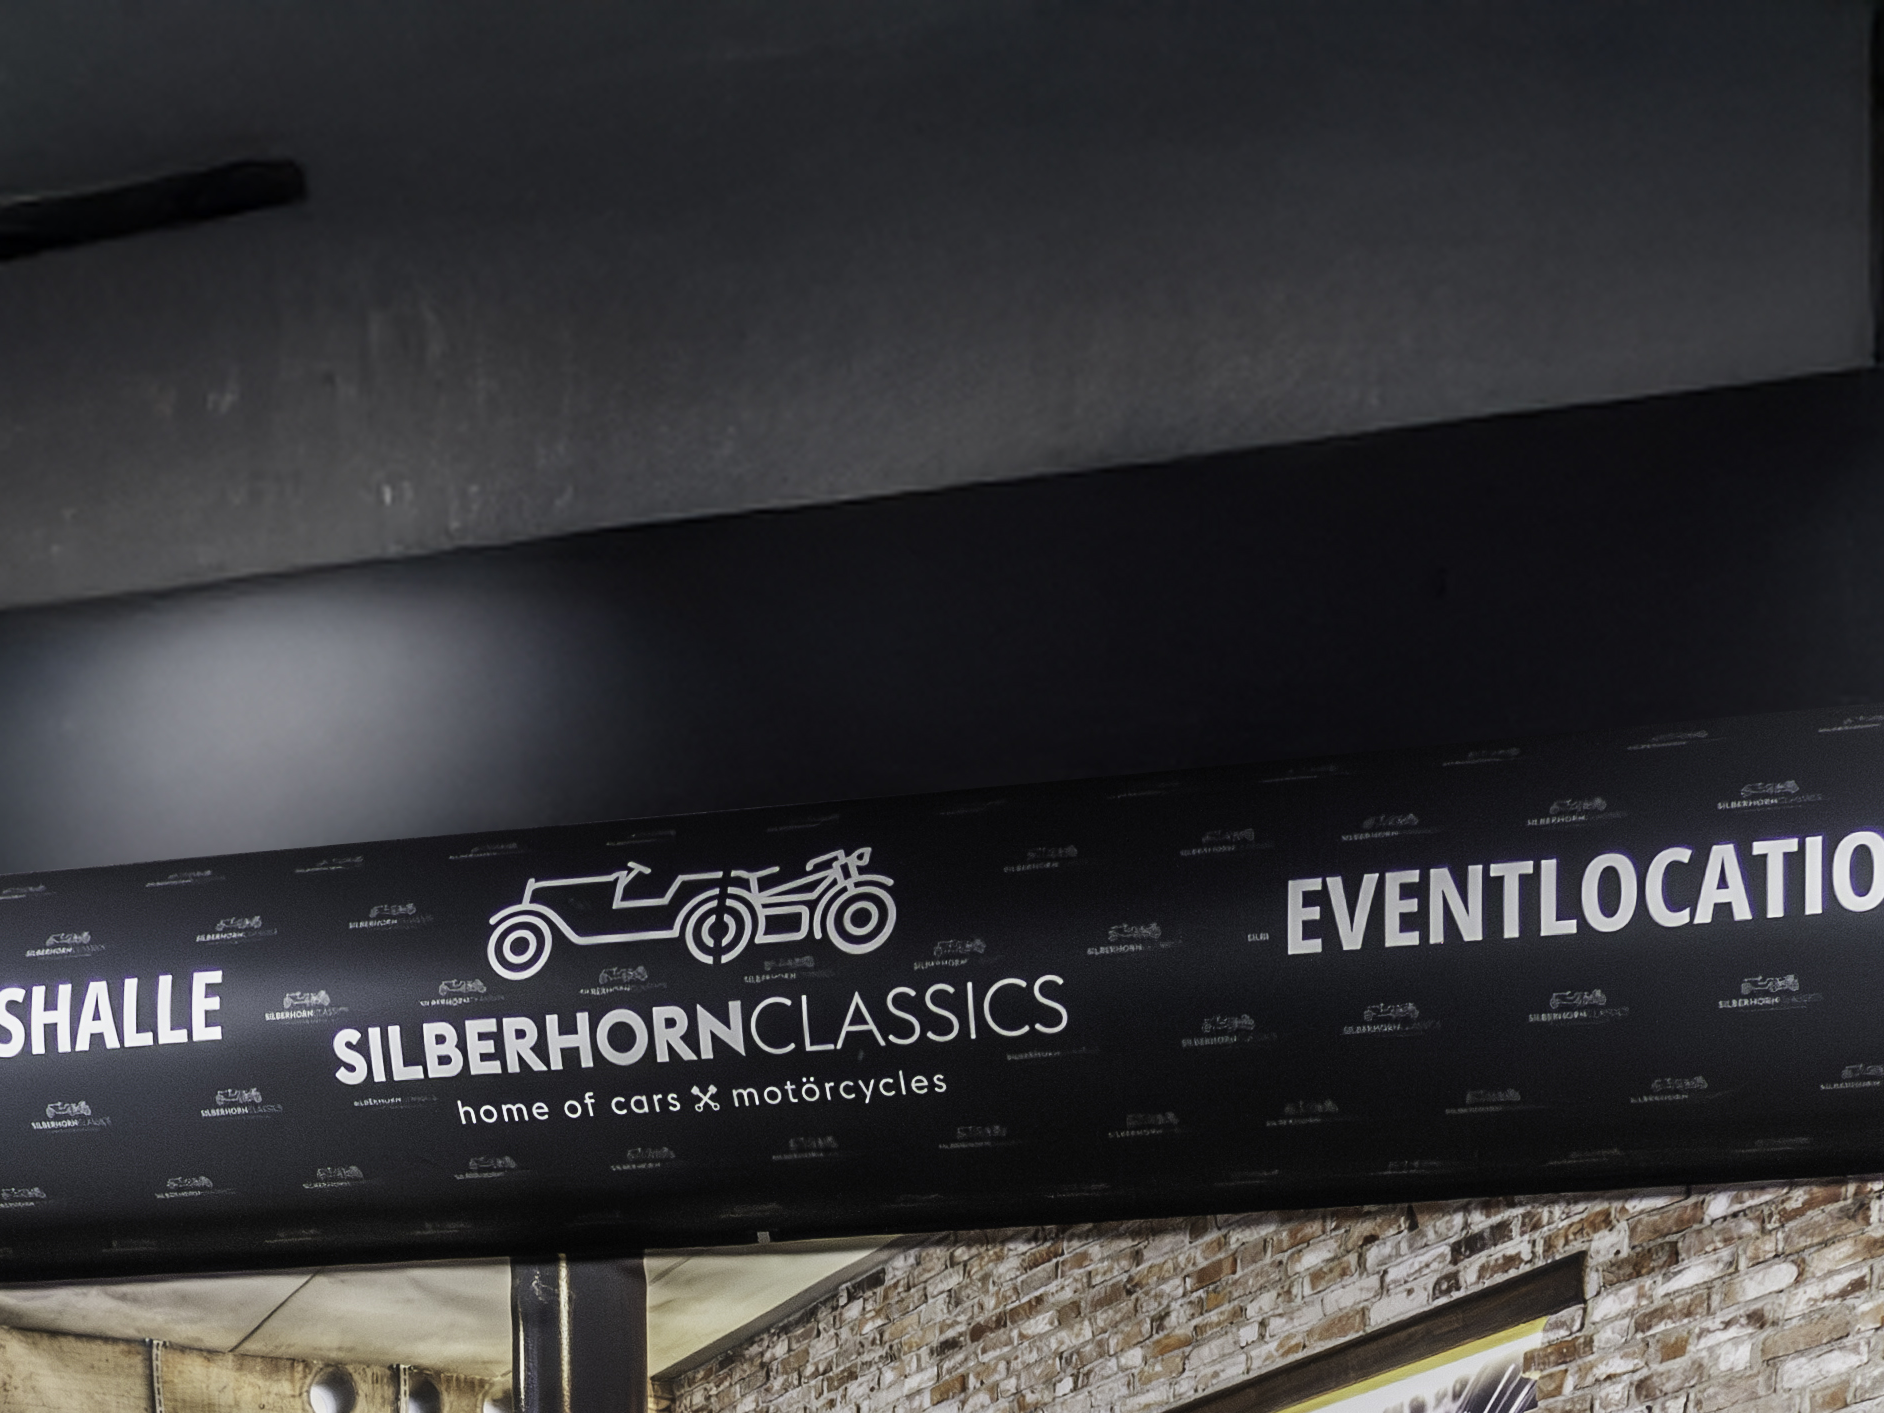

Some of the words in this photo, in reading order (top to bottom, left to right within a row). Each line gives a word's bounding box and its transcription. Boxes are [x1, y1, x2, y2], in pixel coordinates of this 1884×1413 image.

[333, 975, 1068, 1085] SILBERHORNCLASSICS
[457, 1099, 550, 1125] home
[564, 1092, 595, 1118] of
[611, 1093, 681, 1115] cars
[732, 1070, 947, 1107] motörcycles
